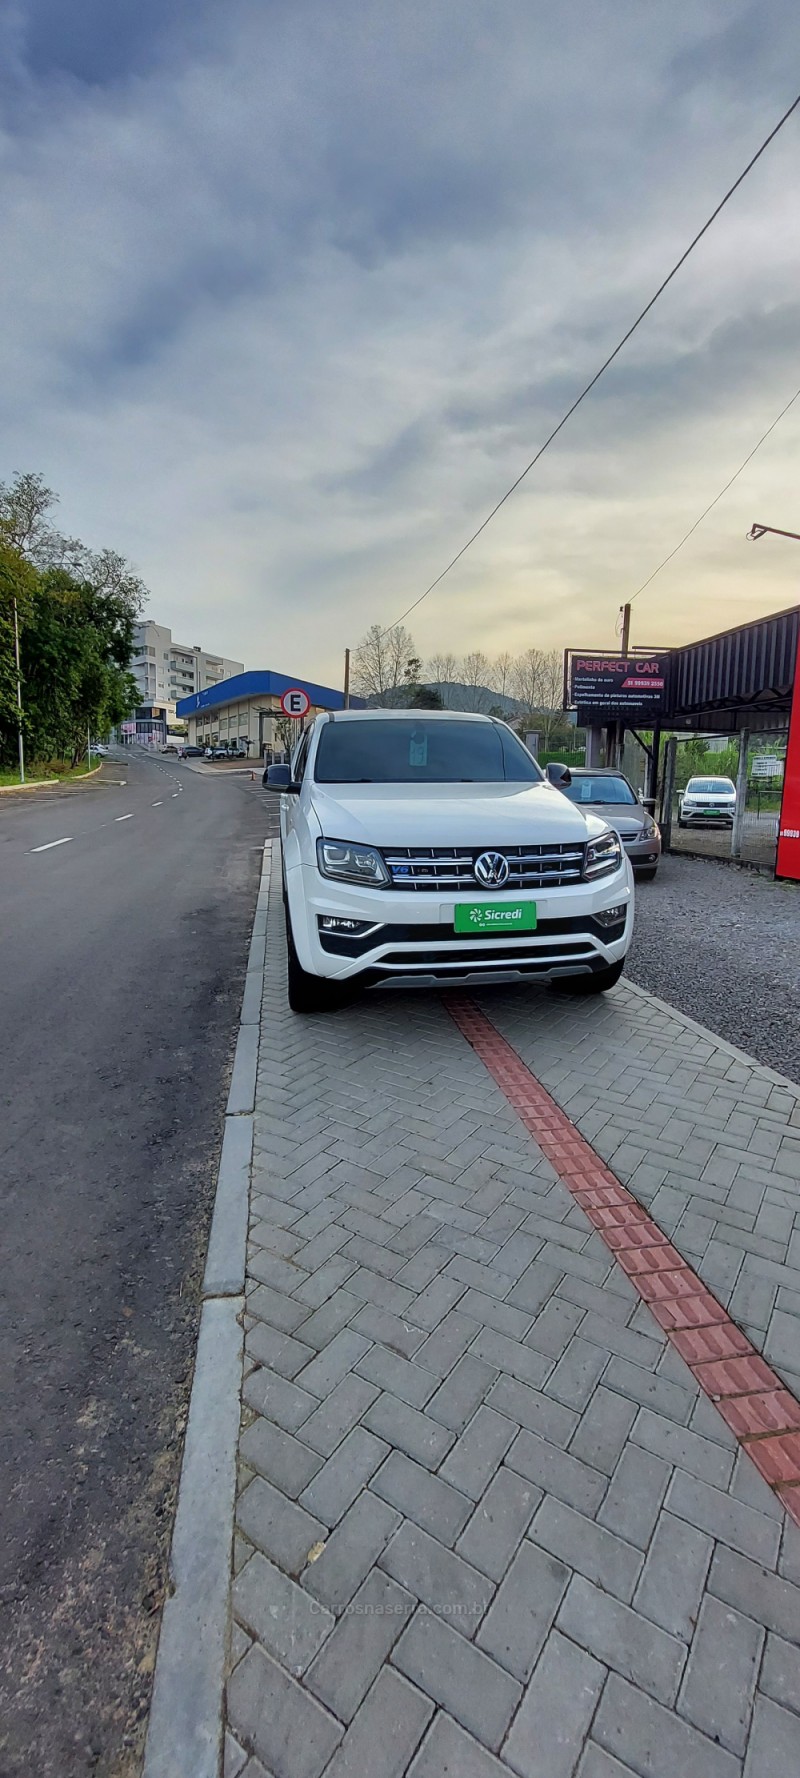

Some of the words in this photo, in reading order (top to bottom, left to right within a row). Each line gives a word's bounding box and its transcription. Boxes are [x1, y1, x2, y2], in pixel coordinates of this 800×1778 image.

[576, 660, 630, 672] PERFECT
[635, 663, 659, 673] CAR
[290, 694, 301, 712] E
[391, 865, 409, 874] V6
[484, 908, 523, 920] Sicredi
